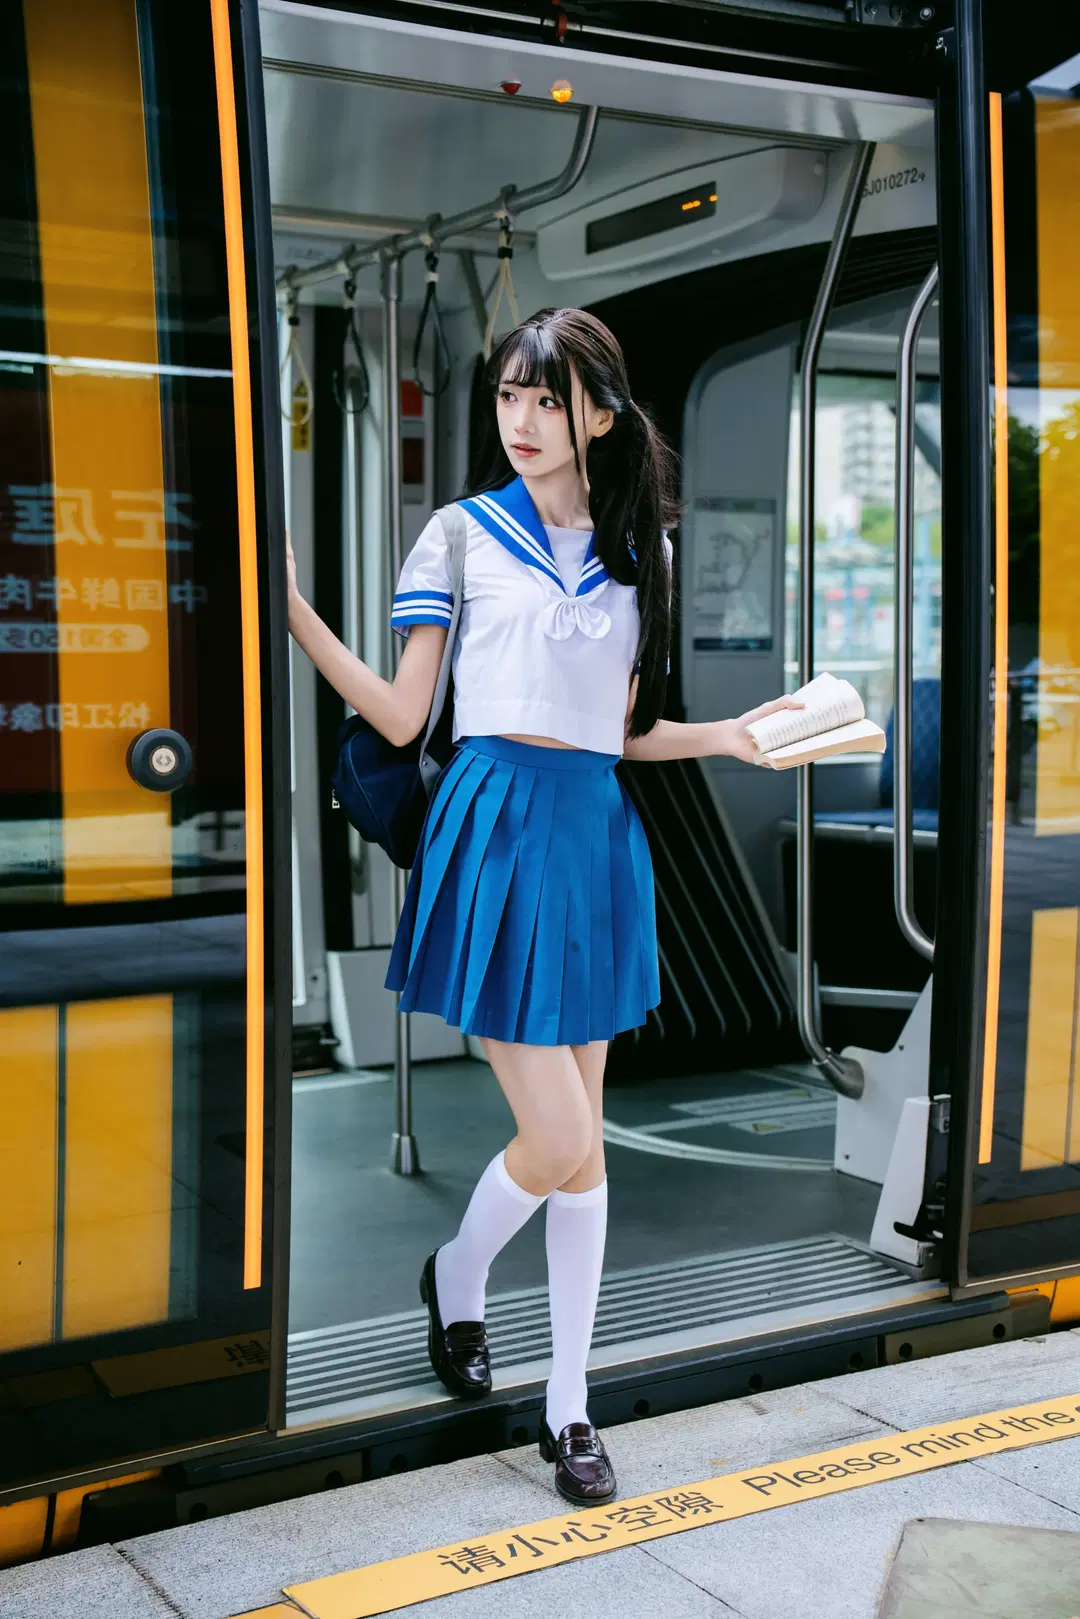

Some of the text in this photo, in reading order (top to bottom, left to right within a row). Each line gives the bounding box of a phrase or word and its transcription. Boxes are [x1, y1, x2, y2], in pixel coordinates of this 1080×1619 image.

[741, 1451, 901, 1496] Please
[900, 1422, 1010, 1458] mind
[999, 1411, 1075, 1433] the
[436, 1491, 724, 1575] 请小心空隙
